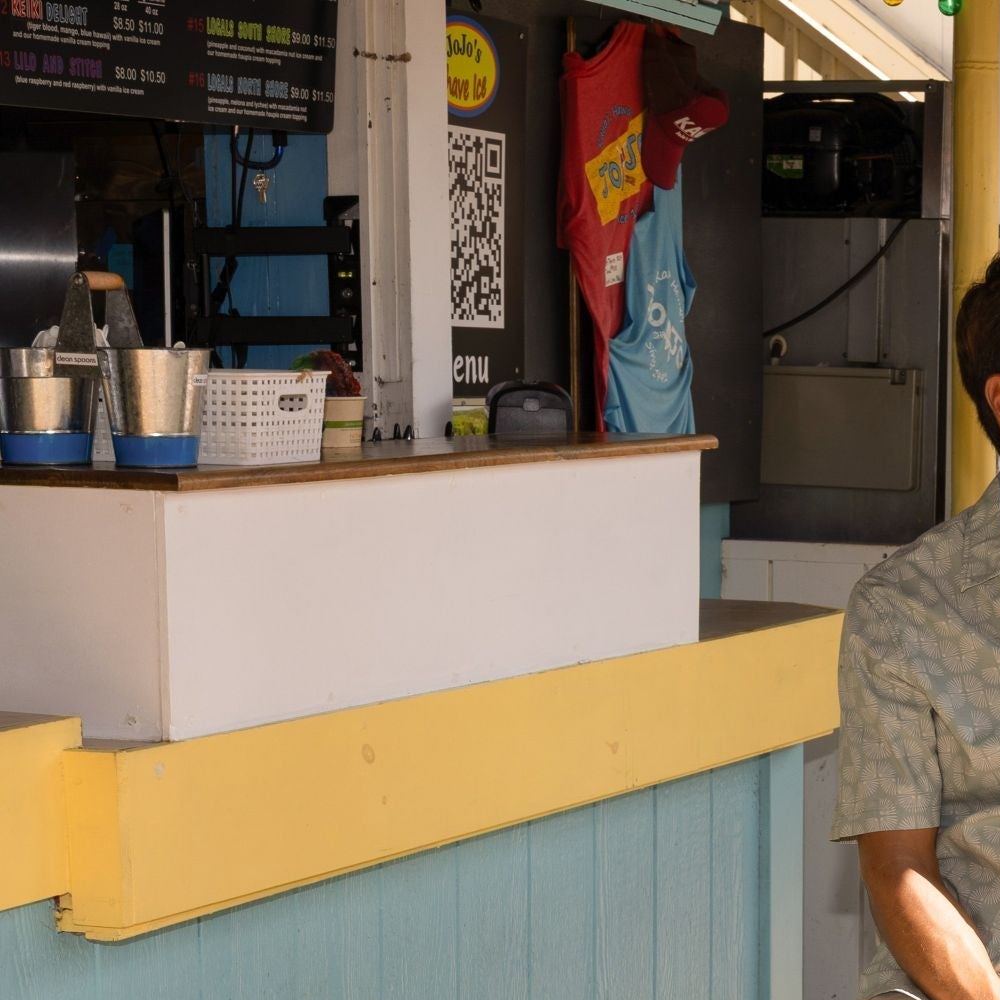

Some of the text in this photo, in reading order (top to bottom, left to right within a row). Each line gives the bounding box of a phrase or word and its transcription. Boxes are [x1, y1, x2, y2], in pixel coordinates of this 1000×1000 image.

[12, 0, 43, 20] KEIKI
[46, 3, 88, 26] DELIGHT
[113, 17, 135, 32] $8.50
[138, 20, 164, 35] $11.00
[145, 7, 151, 15] 40
[33, 34, 60, 43] homemade
[92, 41, 110, 51] topping
[80, 29, 92, 37] blue
[206, 17, 234, 38] LOCALS
[292, 32, 311, 45] $9.00
[313, 35, 335, 49] $11.50
[215, 51, 237, 59] homemade
[265, 58, 281, 66] topping
[447, 34, 481, 64] JoJo's
[43, 54, 64, 75] AND
[115, 66, 137, 81] $8.00
[140, 69, 166, 84] $10.50
[29, 78, 52, 88] raspberry
[72, 82, 96, 92] raspberry)
[107, 86, 122, 94] vanilla
[207, 73, 233, 93] LOCALS
[237, 77, 262, 96] NORTH
[265, 80, 288, 99] SHORE
[290, 87, 309, 100] $9.00
[312, 90, 333, 103] $11.50
[473, 73, 487, 101] Ice
[244, 109, 265, 117] homemade
[292, 114, 307, 123] topping
[57, 354, 73, 362] clean
[453, 355, 489, 384] enu
